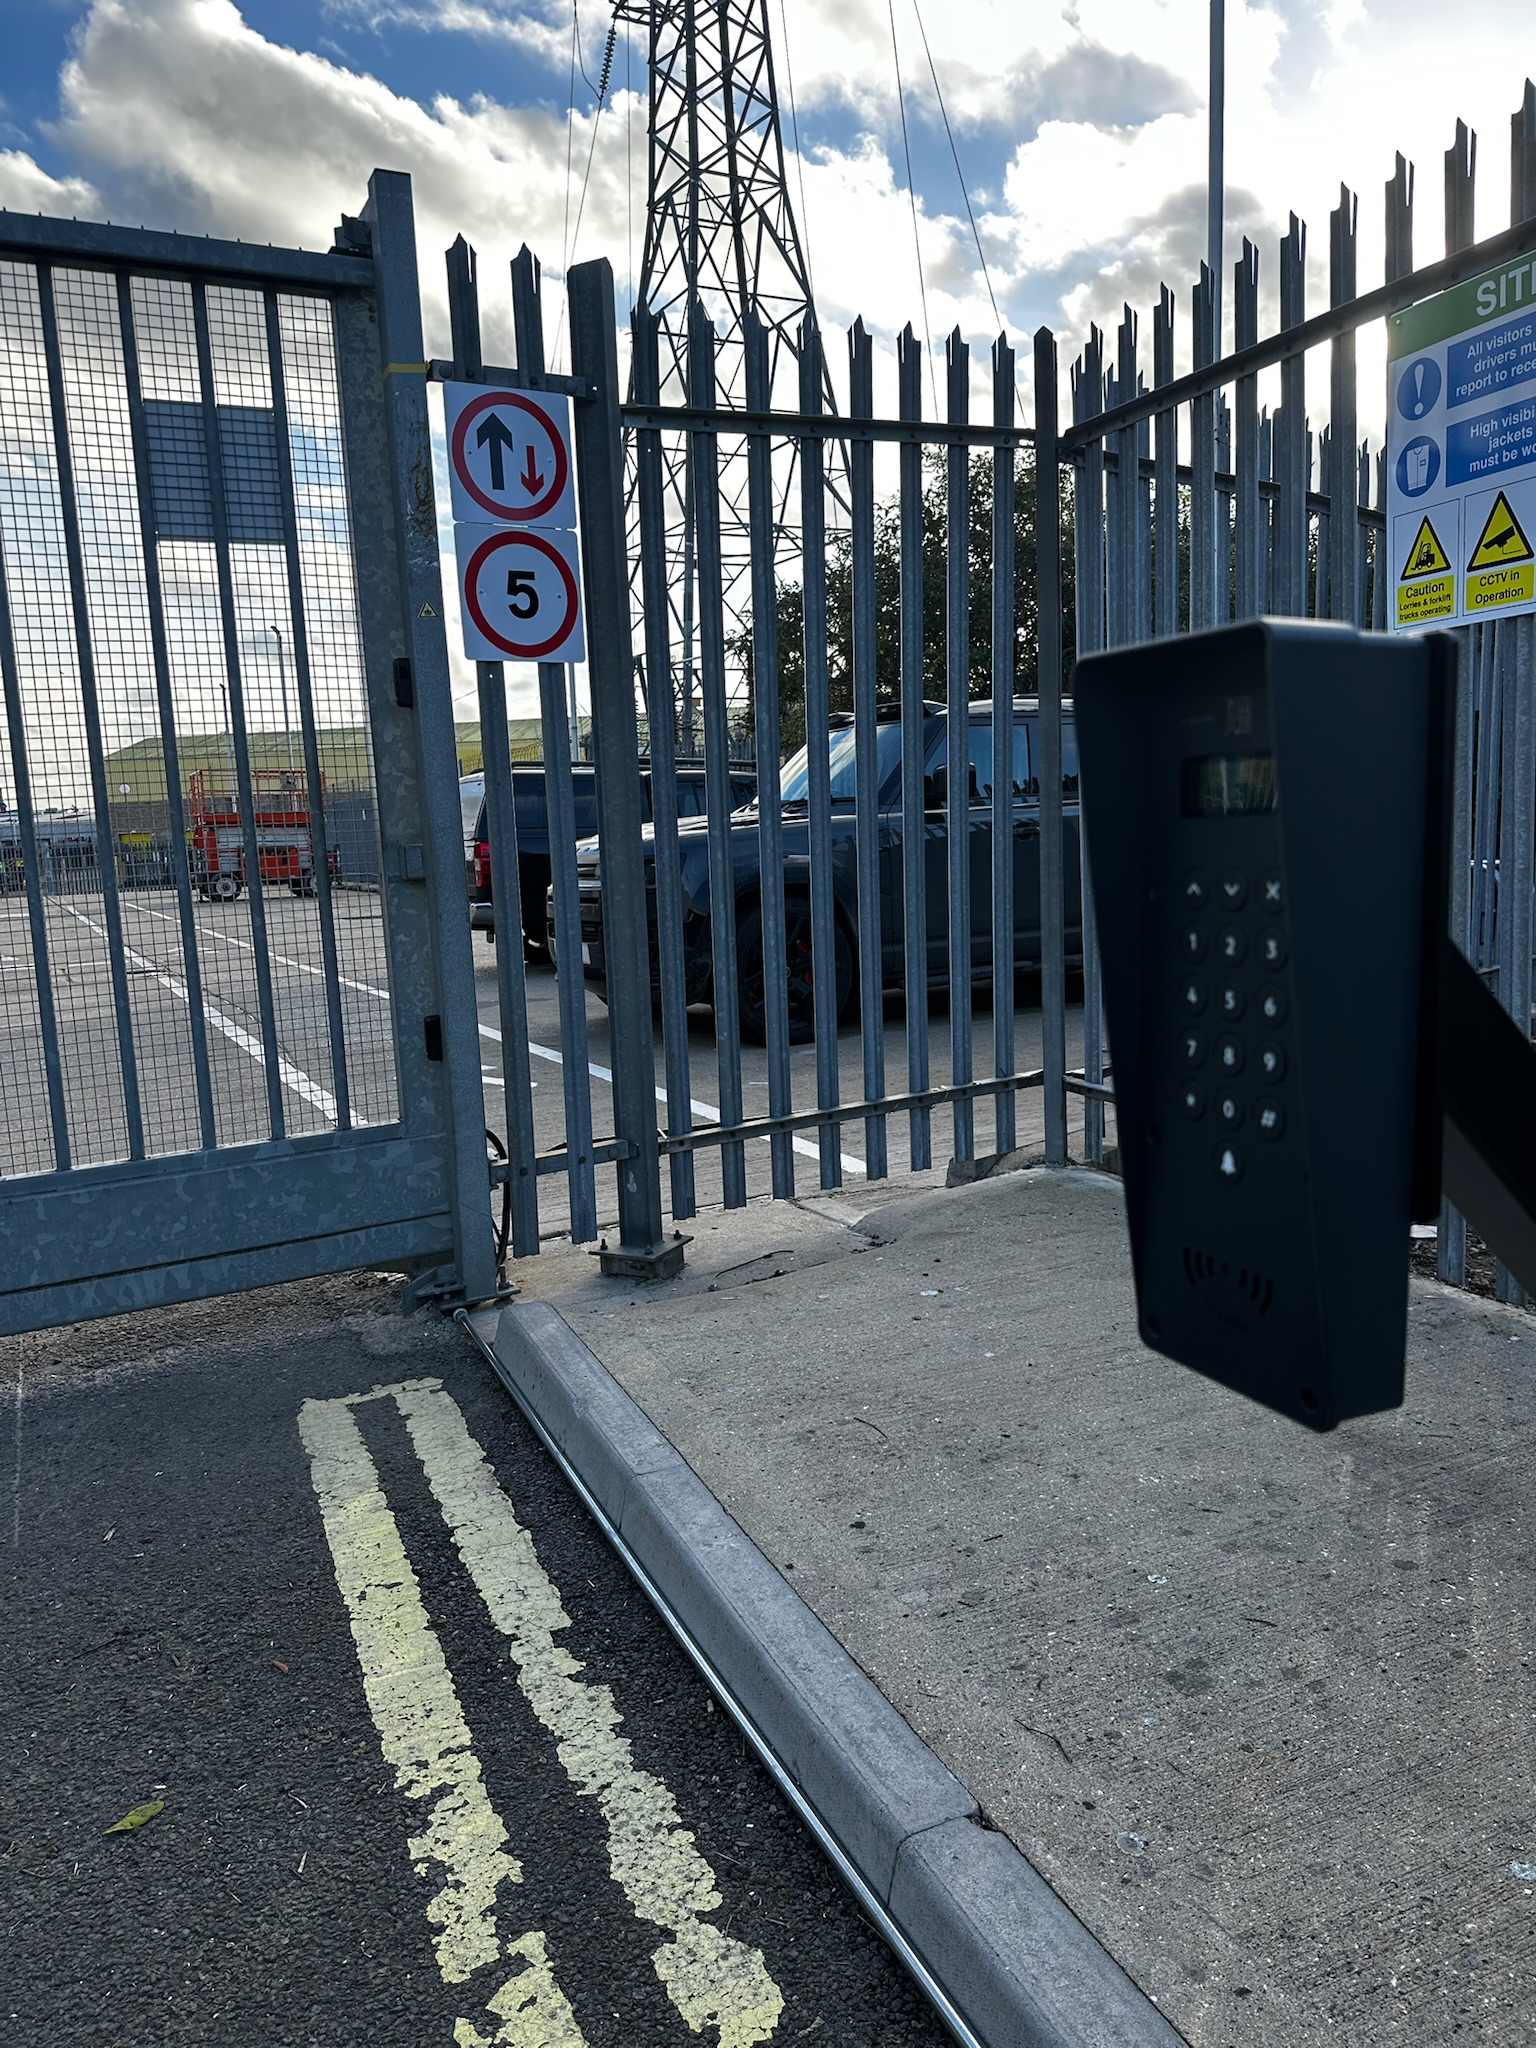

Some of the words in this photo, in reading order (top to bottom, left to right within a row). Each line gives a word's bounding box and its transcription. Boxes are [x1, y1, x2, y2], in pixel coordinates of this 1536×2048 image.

[1476, 261, 1536, 316] SIT
[1467, 341, 1483, 359] All
[1486, 325, 1532, 351] visitors
[1474, 349, 1517, 373] drivers
[1456, 373, 1492, 397] report
[1495, 370, 1507, 382] to
[1470, 419, 1498, 438] High
[1488, 426, 1533, 453] jackets
[1469, 453, 1499, 472] must
[1502, 449, 1518, 462] be
[1405, 582, 1445, 598] Caution
[1480, 572, 1508, 586] CCTV
[1510, 571, 1520, 581] in
[506, 570, 540, 619] 5
[1400, 601, 1421, 611] Lorries
[1423, 598, 1428, 606] &
[1430, 593, 1451, 604] forklift
[1475, 587, 1524, 605] Operation
[1400, 611, 1418, 620] trucks
[1420, 605, 1451, 617] operating
[1189, 932, 1197, 951] 1
[1225, 936, 1236, 956] 2
[1266, 939, 1278, 960] 3
[1187, 986, 1198, 1004] 4
[1224, 989, 1235, 1010] 5
[1264, 997, 1277, 1017] 6
[1187, 1039, 1197, 1057] 7
[1223, 1046, 1235, 1066] 8
[1263, 1052, 1276, 1072] 9
[1223, 1099, 1235, 1119] 0
